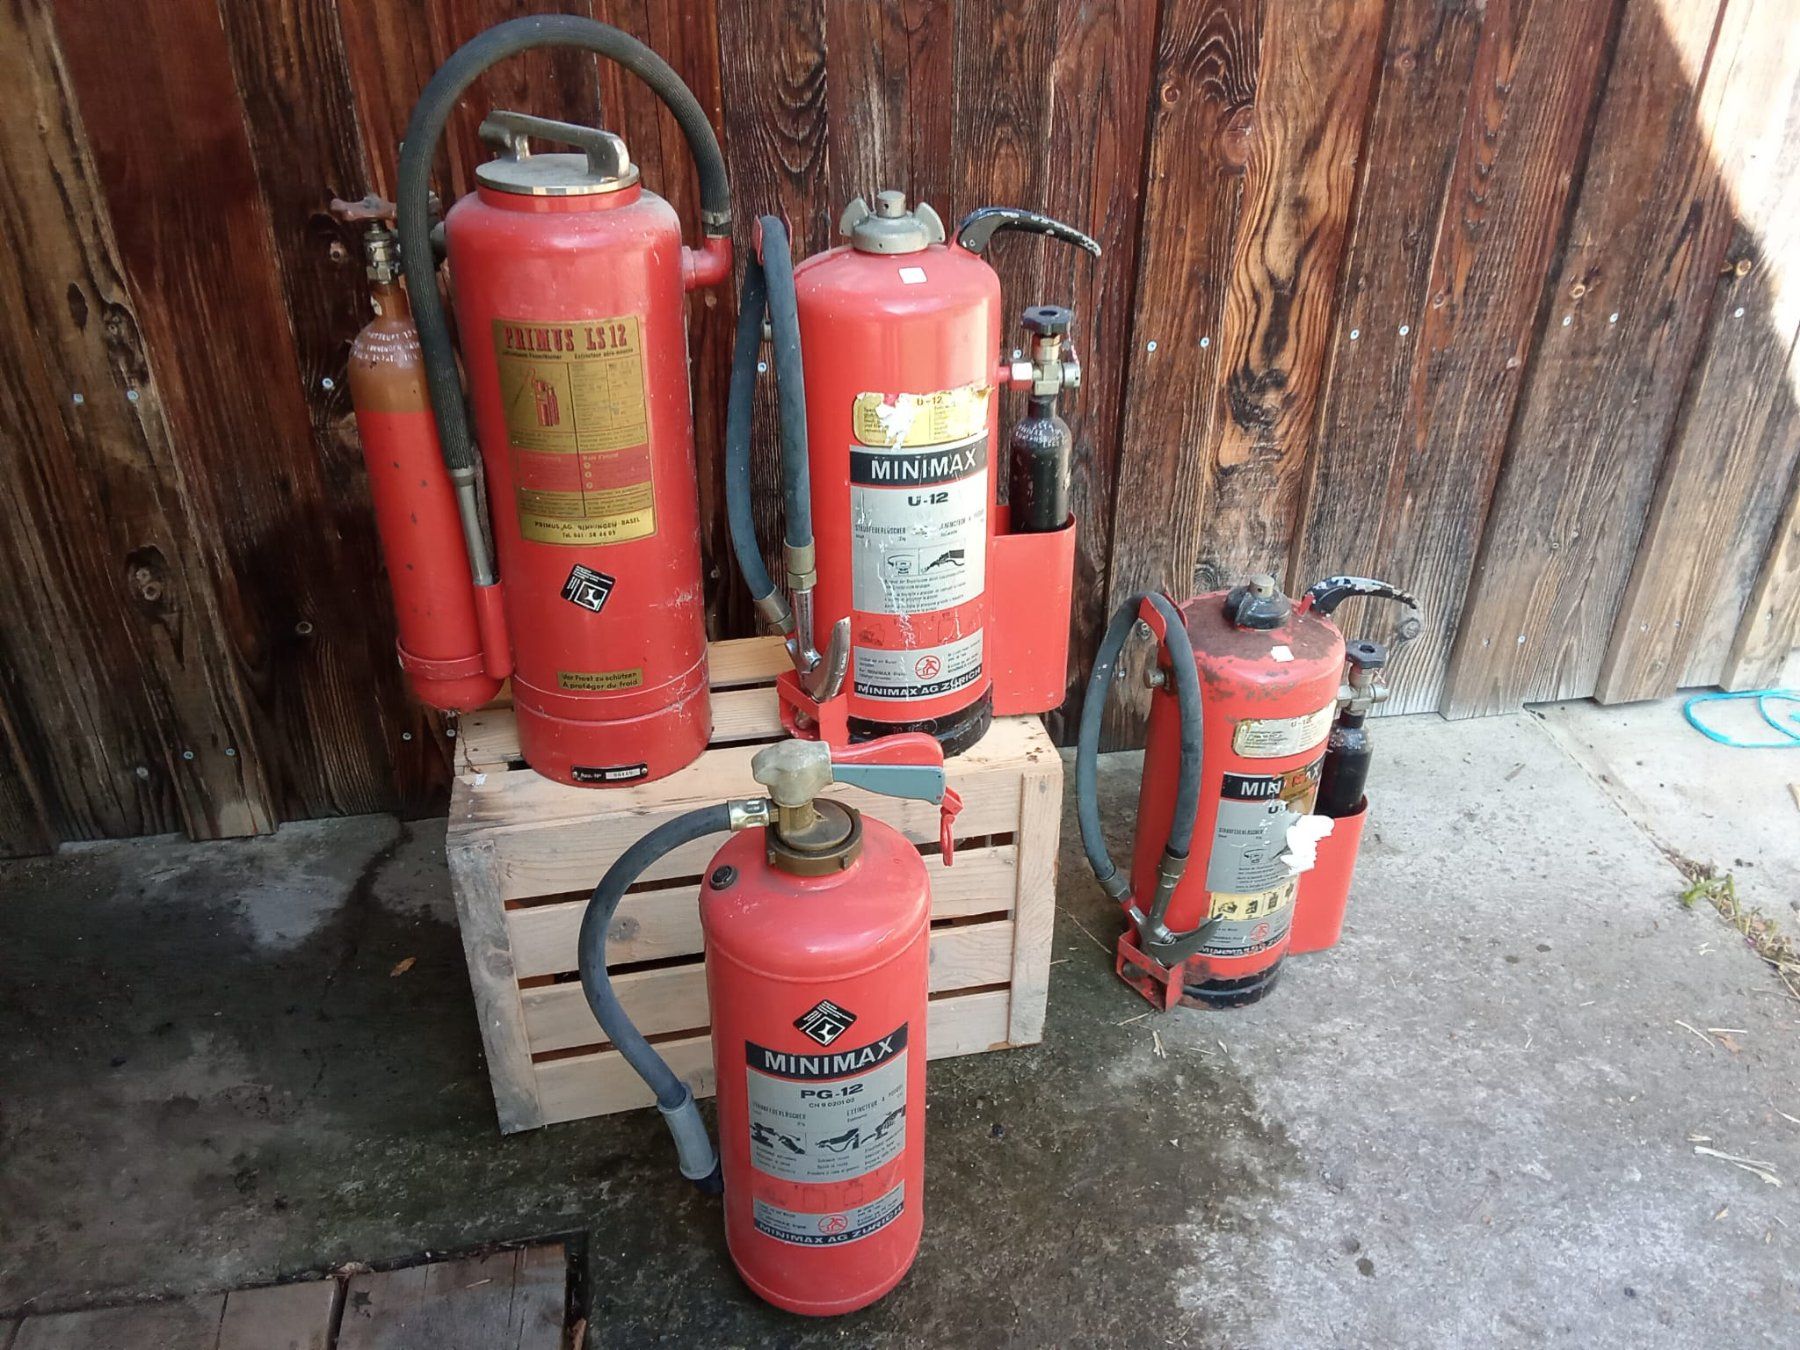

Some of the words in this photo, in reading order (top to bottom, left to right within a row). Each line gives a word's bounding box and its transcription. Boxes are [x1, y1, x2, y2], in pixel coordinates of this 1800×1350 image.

[503, 326, 575, 352] PRIMUS
[871, 446, 978, 480] MINIMAX
[907, 491, 949, 507] U-12
[534, 521, 560, 530] PRIMUS
[621, 517, 640, 526] BASEL
[575, 674, 593, 682] Frost
[857, 683, 918, 696] MINIMAX
[920, 685, 939, 695] AG
[765, 1035, 893, 1075] MINIMAX
[800, 1083, 864, 1100] PG-12
[758, 1223, 823, 1244] MINIMAX
[827, 1234, 848, 1243] AG
